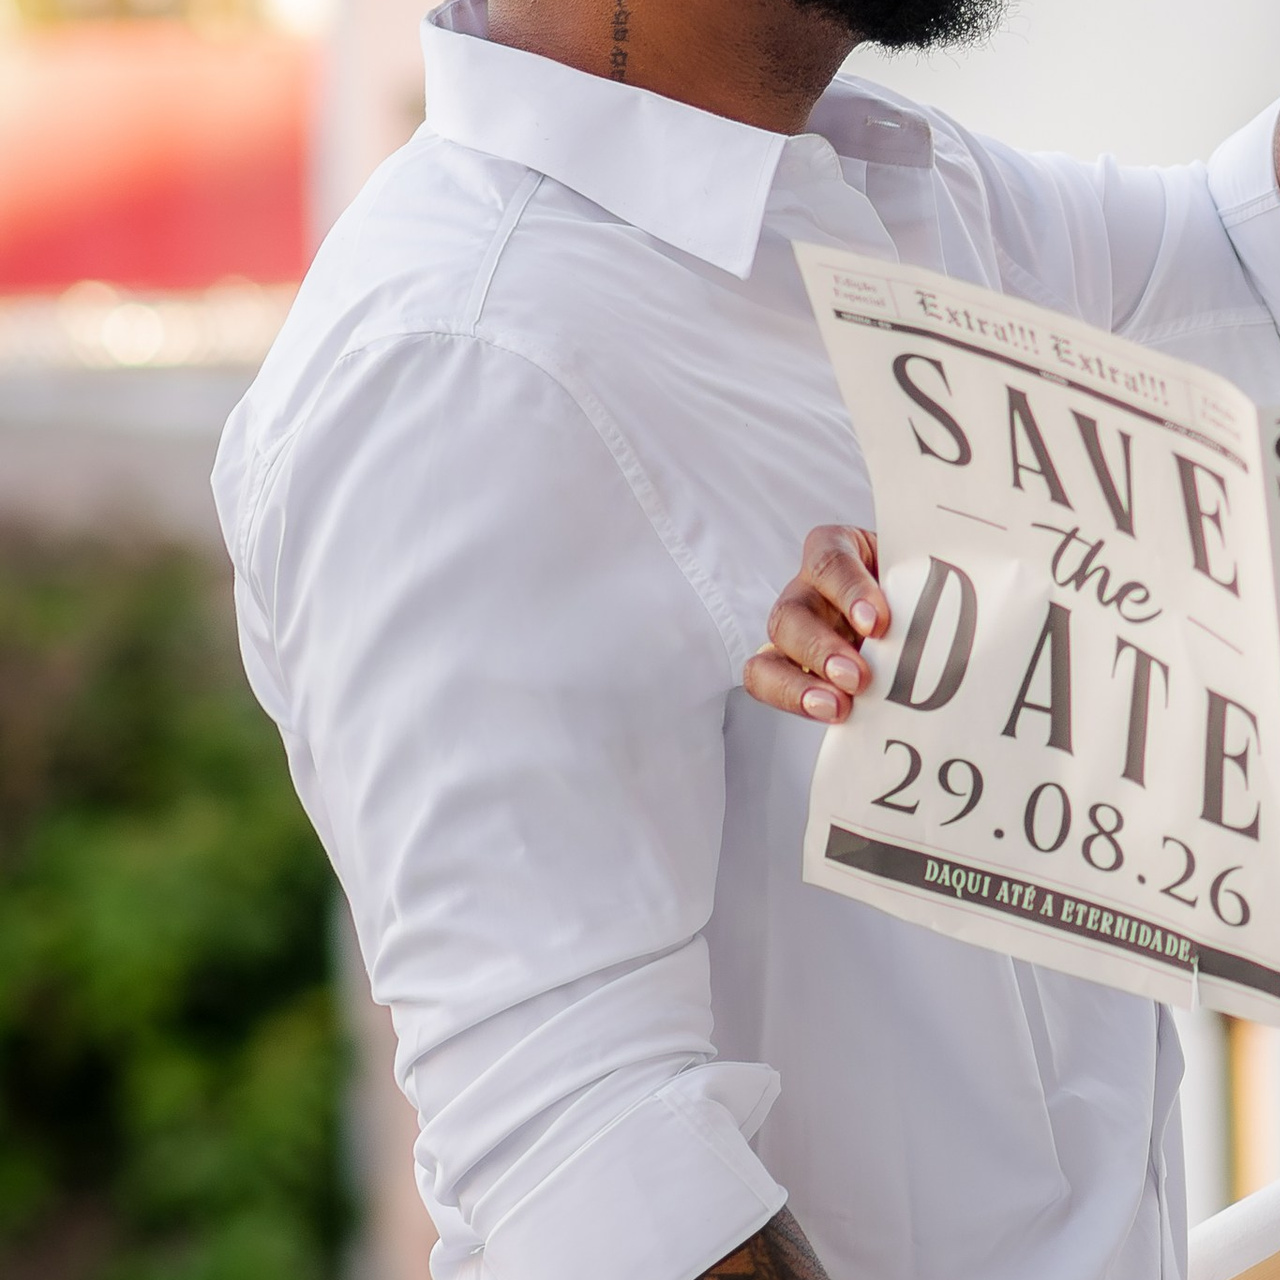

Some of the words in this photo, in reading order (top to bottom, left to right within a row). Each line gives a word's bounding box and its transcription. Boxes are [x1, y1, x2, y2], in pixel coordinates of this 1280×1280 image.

[915, 290, 1039, 355] Extra!!!
[1050, 334, 1169, 406] Extra!!!
[892, 353, 1241, 598] SAVE
[1031, 522, 1162, 624] the
[885, 556, 1261, 842] DATE
[870, 739, 1252, 928] 29.08.26
[924, 859, 991, 898] DAQUI
[995, 880, 1036, 912] ATÉ
[1039, 894, 1054, 918] A
